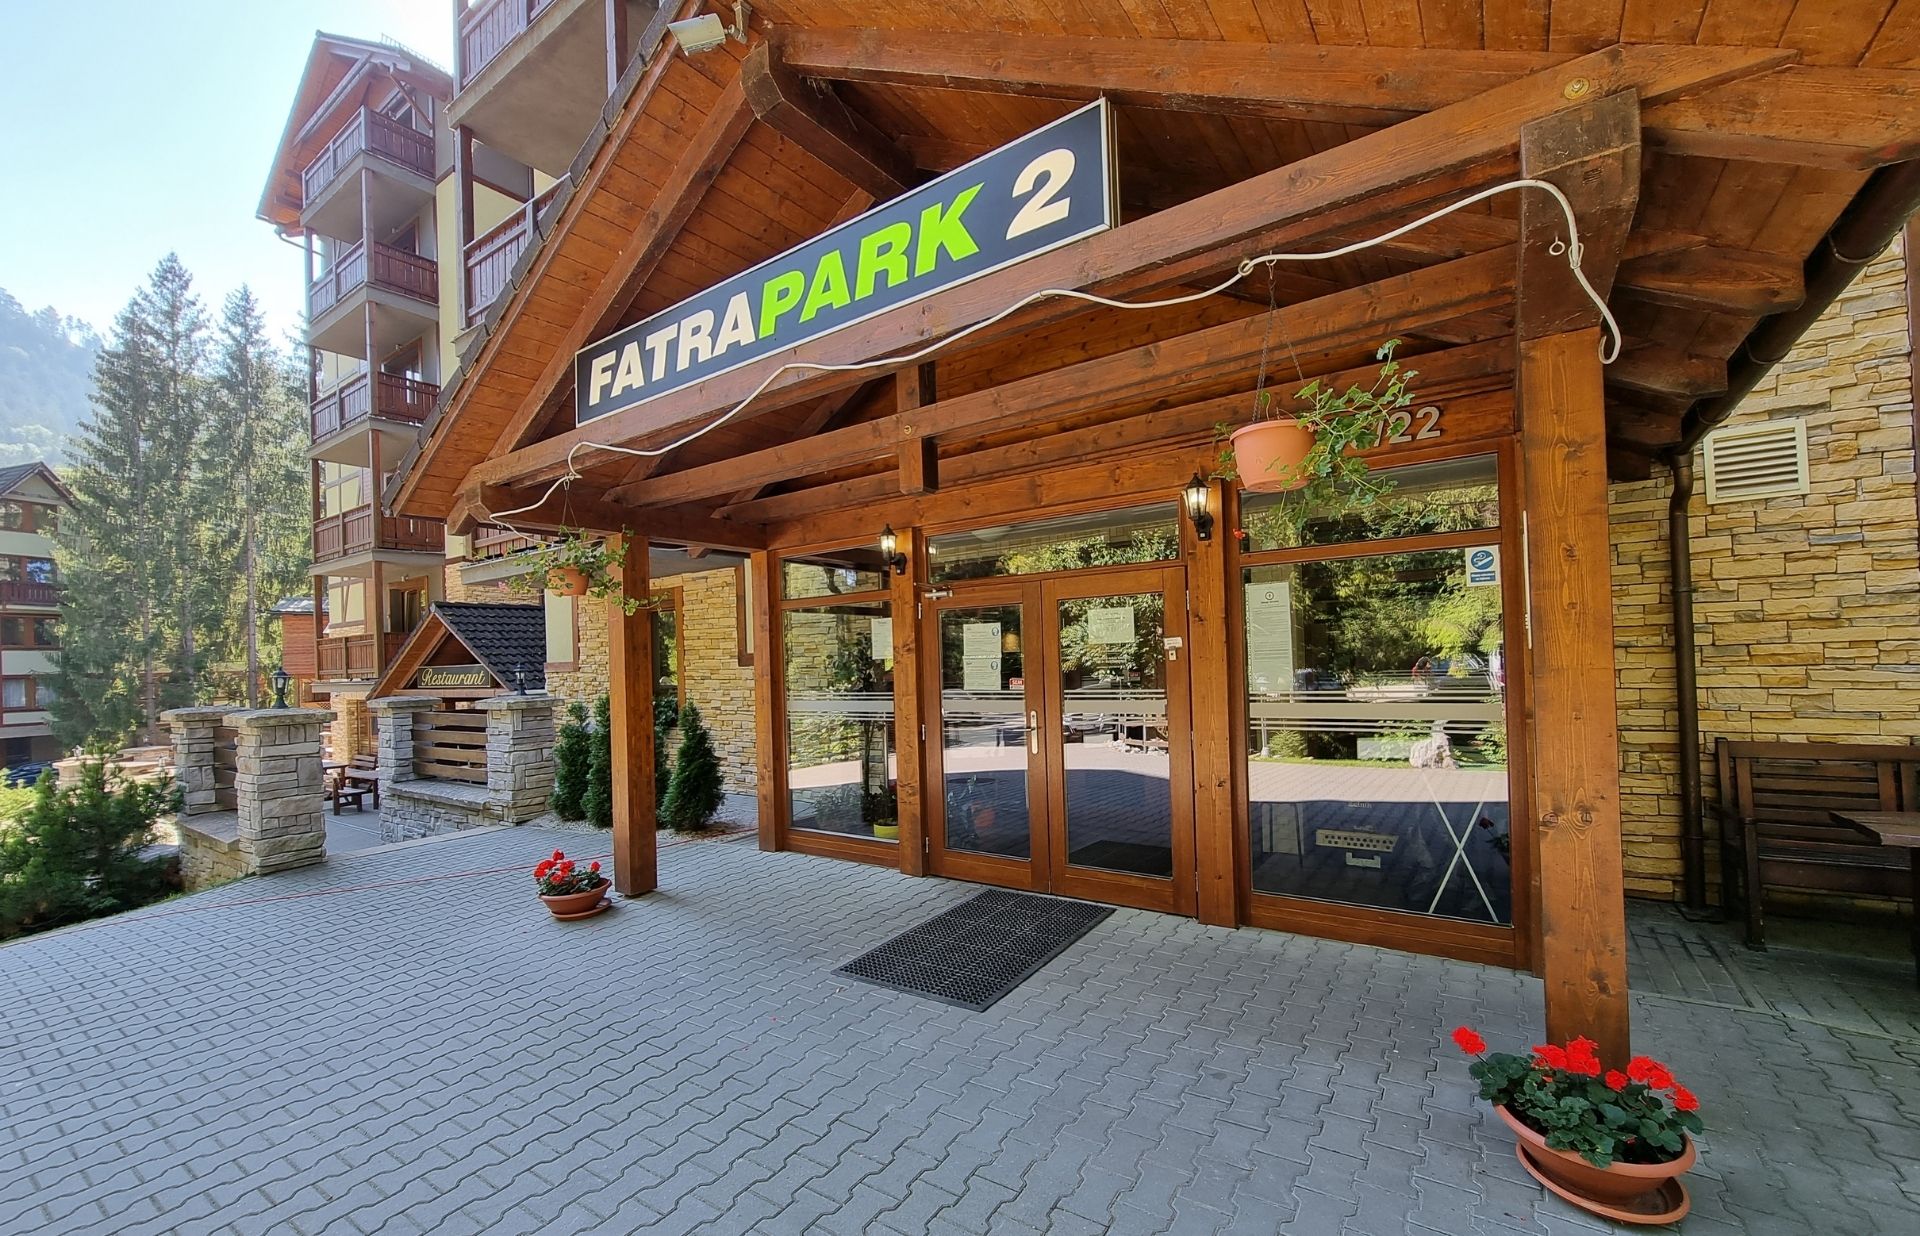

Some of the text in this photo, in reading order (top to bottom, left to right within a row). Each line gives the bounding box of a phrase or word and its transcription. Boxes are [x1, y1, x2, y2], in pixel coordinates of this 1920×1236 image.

[588, 148, 1077, 407] FATRAPARK 2
[421, 668, 486, 686] Restaurant
